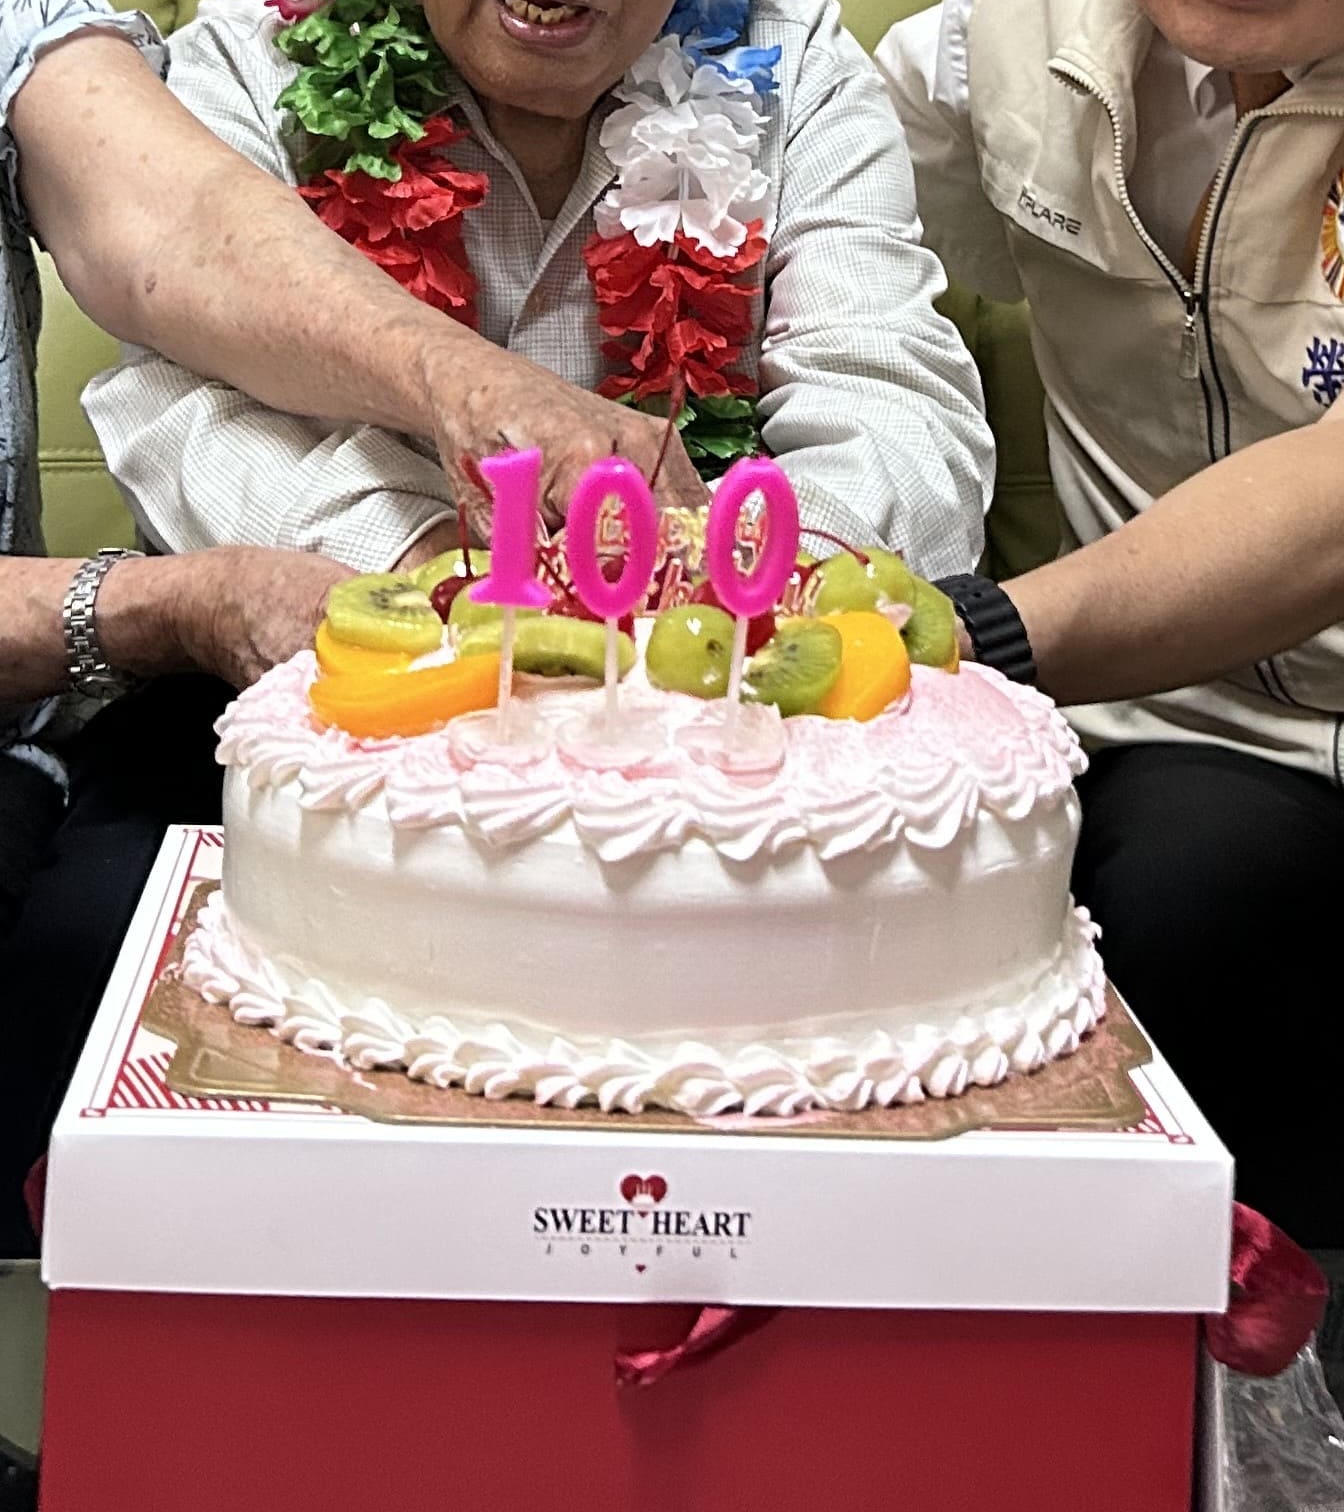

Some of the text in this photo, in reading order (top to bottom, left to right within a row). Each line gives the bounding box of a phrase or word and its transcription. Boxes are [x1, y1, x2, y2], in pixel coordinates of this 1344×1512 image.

[469, 446, 800, 619] 100
[533, 1206, 752, 1238] SWEET HEART
